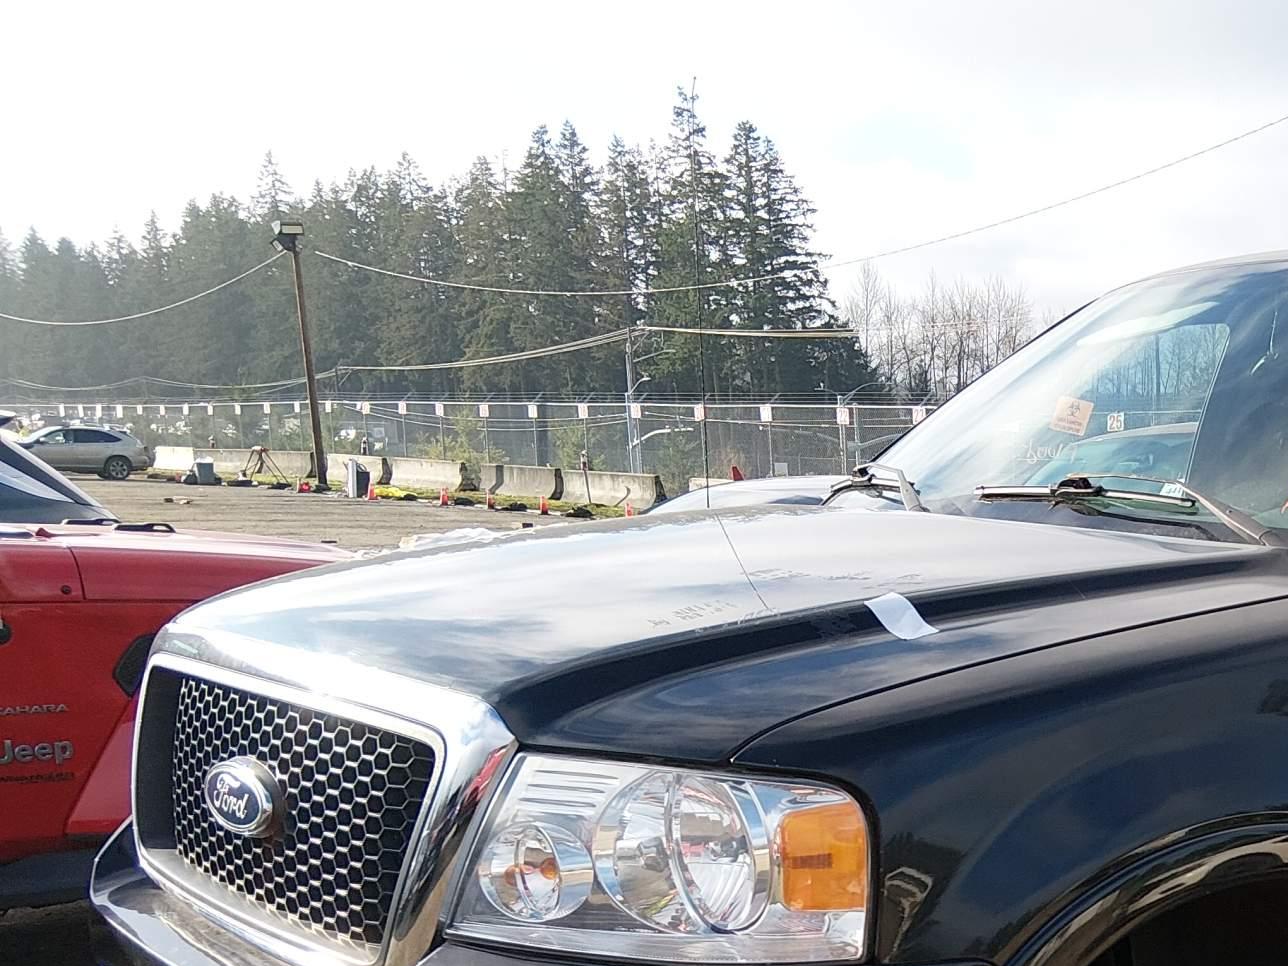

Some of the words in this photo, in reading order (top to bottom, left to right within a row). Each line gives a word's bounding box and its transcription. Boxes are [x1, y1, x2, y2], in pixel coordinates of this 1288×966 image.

[1108, 414, 1123, 430] 25
[0, 739, 75, 765] Jeep
[213, 772, 250, 819] Ford
